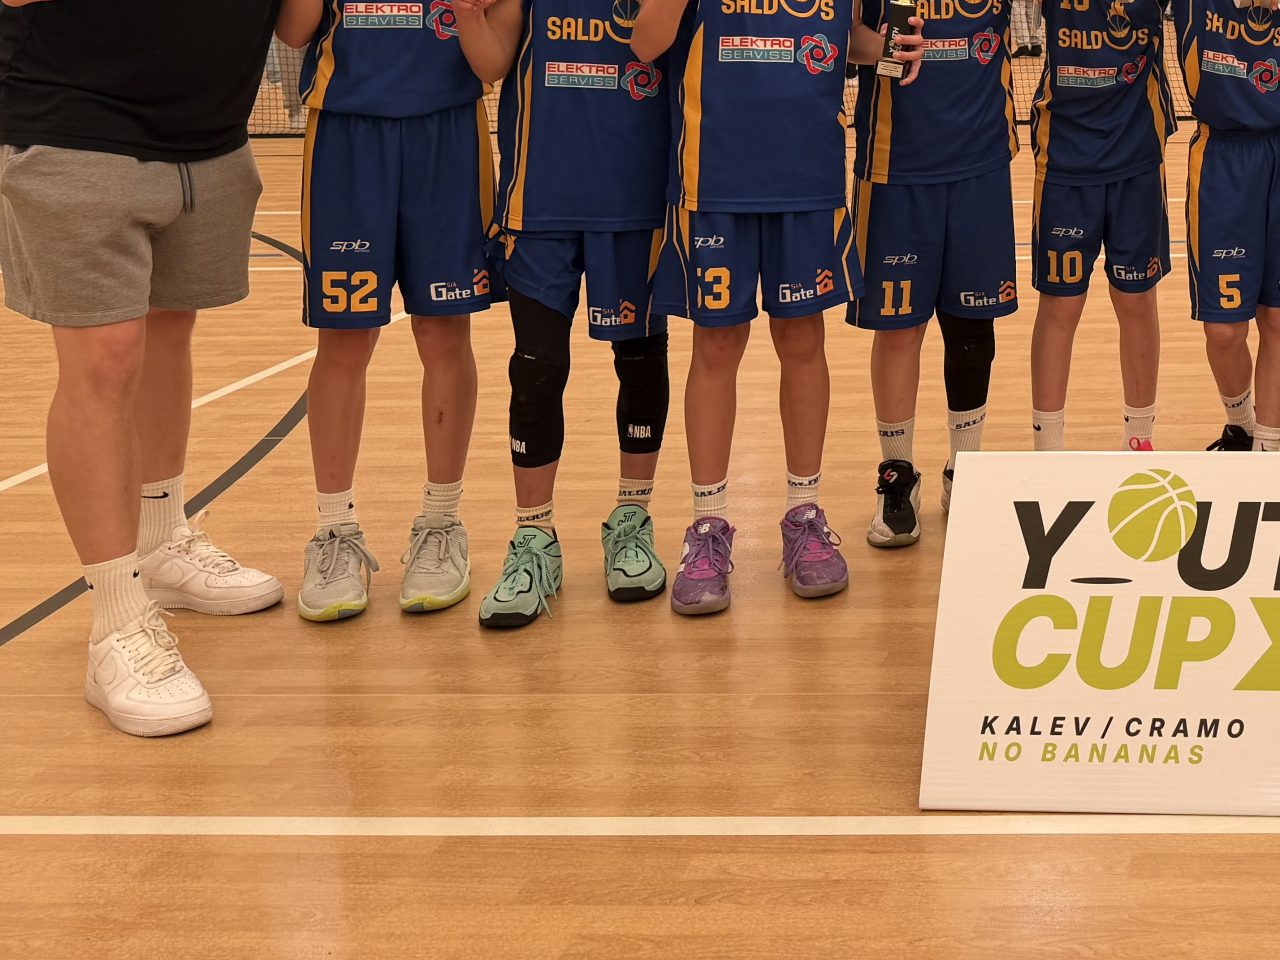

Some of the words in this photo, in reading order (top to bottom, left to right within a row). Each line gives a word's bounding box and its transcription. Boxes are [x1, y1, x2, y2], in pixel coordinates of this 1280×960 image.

[344, 4, 422, 15] ELEKTRO
[345, 16, 422, 27] SERVISS
[720, 37, 794, 49] ELEKTRO
[720, 49, 793, 61] SERVISS
[547, 64, 617, 76] ELEKTRO
[1058, 66, 1117, 77] ELEKTRO
[546, 74, 616, 88] SERVISS
[1058, 76, 1116, 88] SERVISS
[1051, 227, 1084, 238] spb
[330, 238, 371, 253] spb
[1212, 246, 1247, 259] spb
[882, 253, 918, 266] spb
[1046, 249, 1083, 285] 10
[1112, 264, 1146, 281] Gate
[321, 270, 378, 313] 52
[429, 282, 471, 302] Gate
[778, 284, 815, 304] Gate
[880, 279, 913, 316] 11
[1217, 273, 1242, 310] 5
[633, 424, 651, 439] NBA
[511, 437, 527, 455] NBA
[991, 593, 1237, 691] CUP
[981, 715, 1091, 738] KALEV
[1100, 716, 1114, 738] /
[1126, 717, 1247, 739] CRAMO
[978, 741, 1024, 762] NO
[1041, 742, 1206, 765] BANANAS
